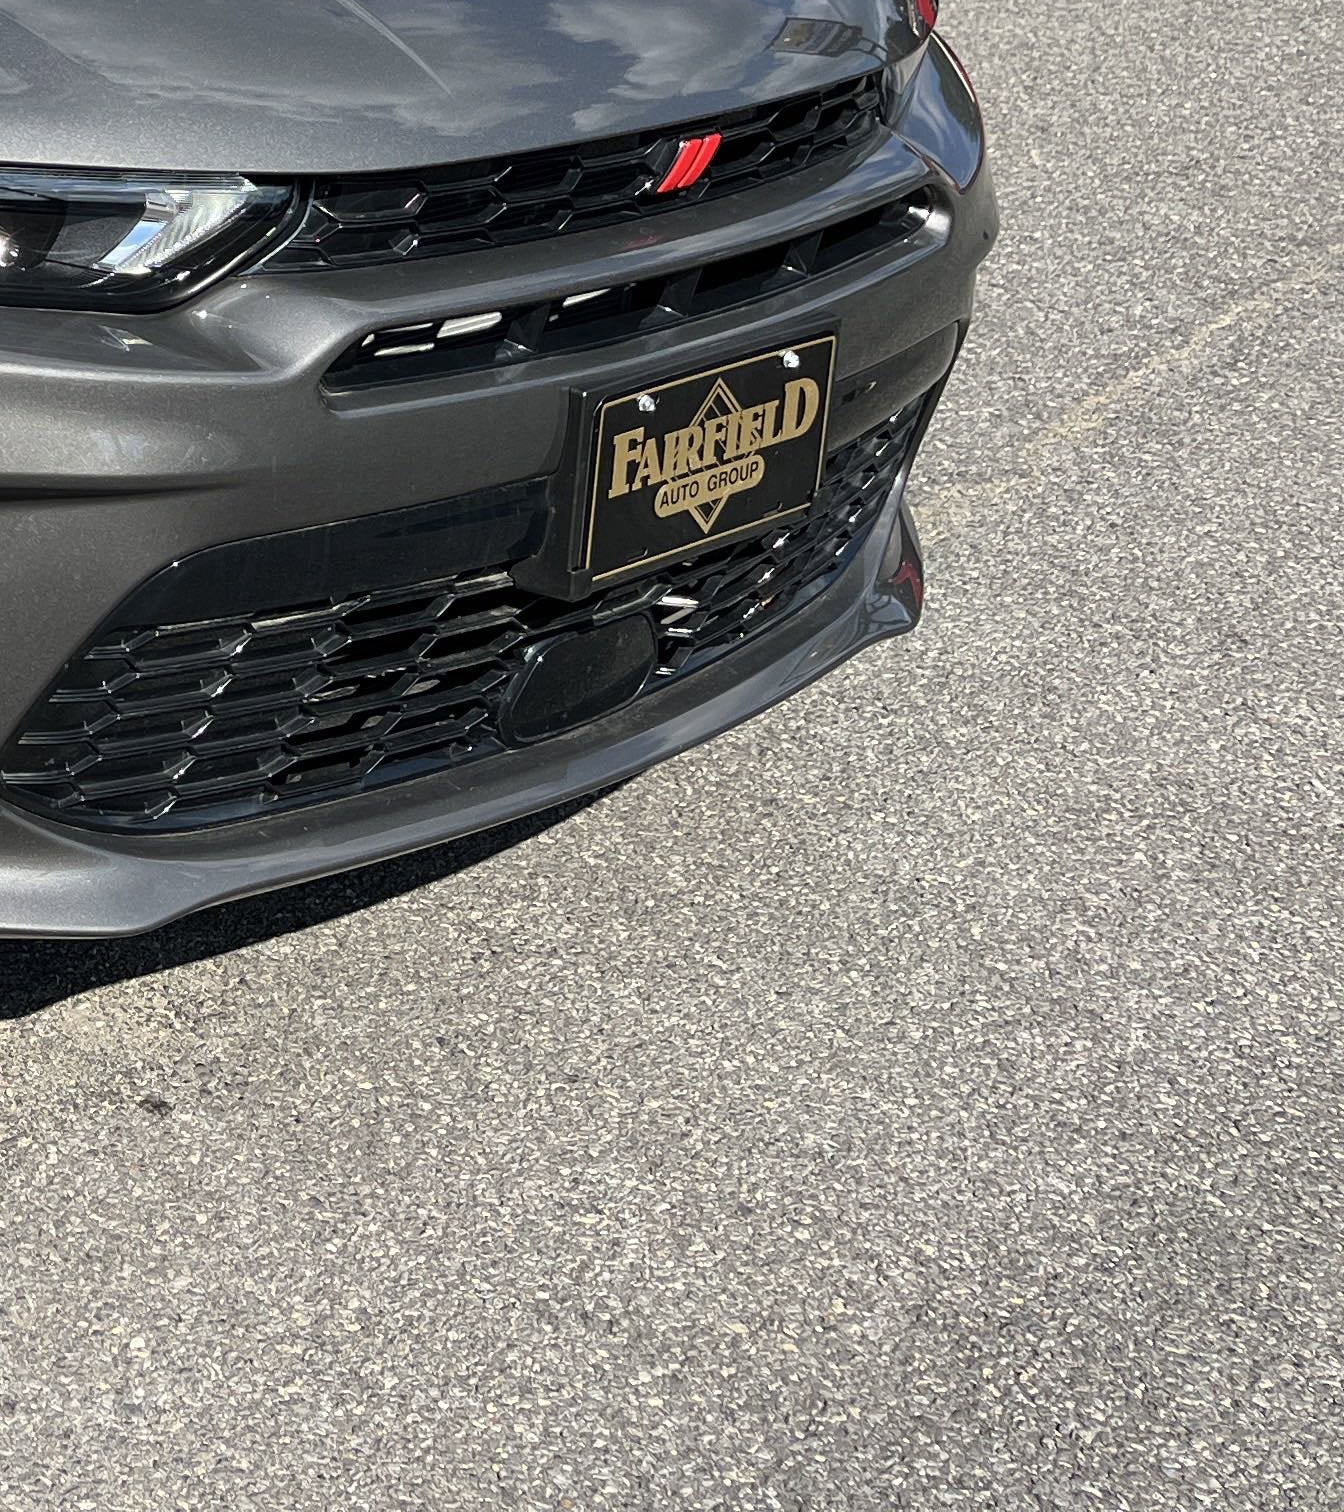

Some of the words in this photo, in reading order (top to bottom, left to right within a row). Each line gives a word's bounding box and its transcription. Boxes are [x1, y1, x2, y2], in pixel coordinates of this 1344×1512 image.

[608, 377, 820, 499] FAIRFIELD
[659, 479, 700, 508] AUTO
[707, 461, 761, 491] GROUP
